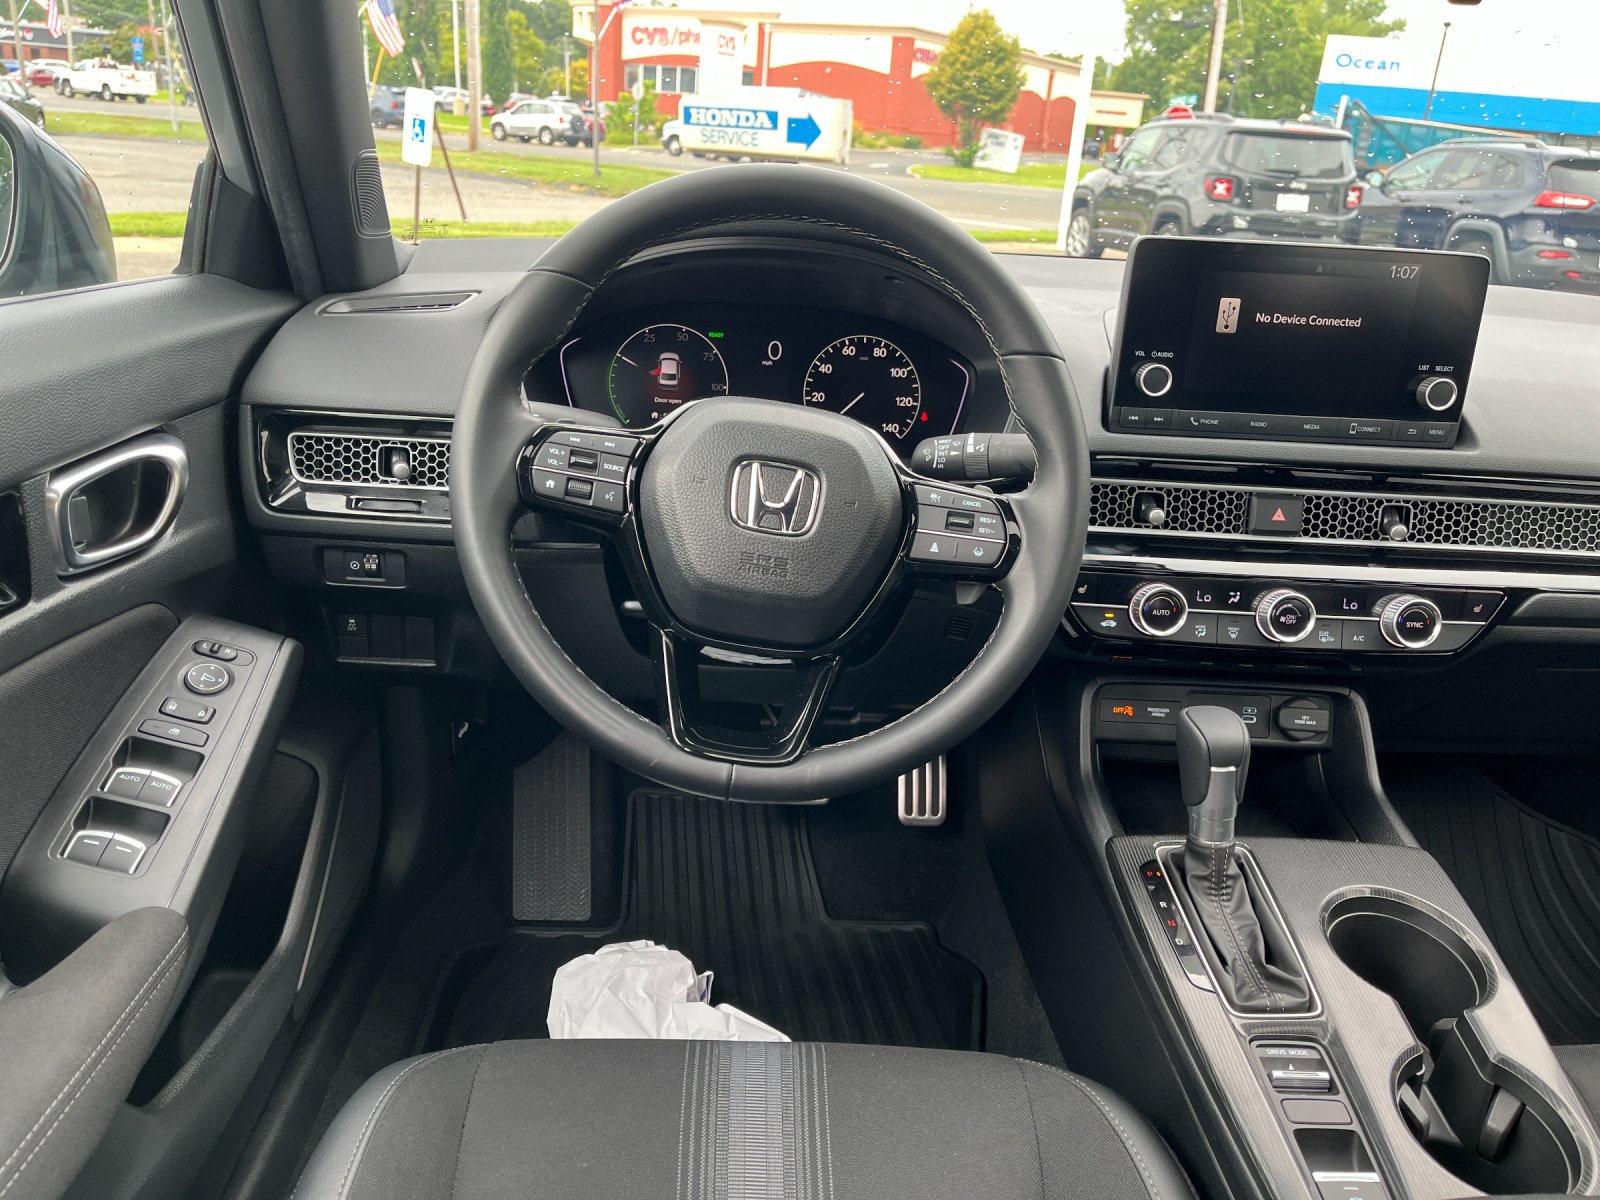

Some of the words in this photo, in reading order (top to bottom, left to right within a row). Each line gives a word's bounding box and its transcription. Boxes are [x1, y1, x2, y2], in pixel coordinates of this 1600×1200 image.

[1336, 53, 1401, 71] Ocean
[689, 107, 773, 129] HONDA
[700, 128, 759, 147] SERVICE
[1390, 265, 1420, 279] 1:07
[1255, 313, 1271, 323] No
[1273, 314, 1307, 325] Device
[1308, 315, 1362, 328] Connected
[643, 334, 656, 343] 25
[676, 333, 689, 342] 50
[767, 341, 782, 360] 0
[842, 346, 855, 356] 60
[873, 348, 887, 358] 80
[703, 353, 714, 361] 75
[819, 364, 832, 374] 40
[889, 368, 907, 378] 100
[711, 383, 724, 391] 100
[811, 392, 825, 402] 20
[895, 397, 913, 407] 120
[881, 423, 899, 433] 140
[603, 463, 624, 472] SOURCE
[962, 500, 982, 508] CANCEL
[1152, 608, 1171, 616] AUTO
[119, 774, 140, 782] AUTO
[150, 780, 172, 790] AUTO
[1167, 919, 1176, 927] N
